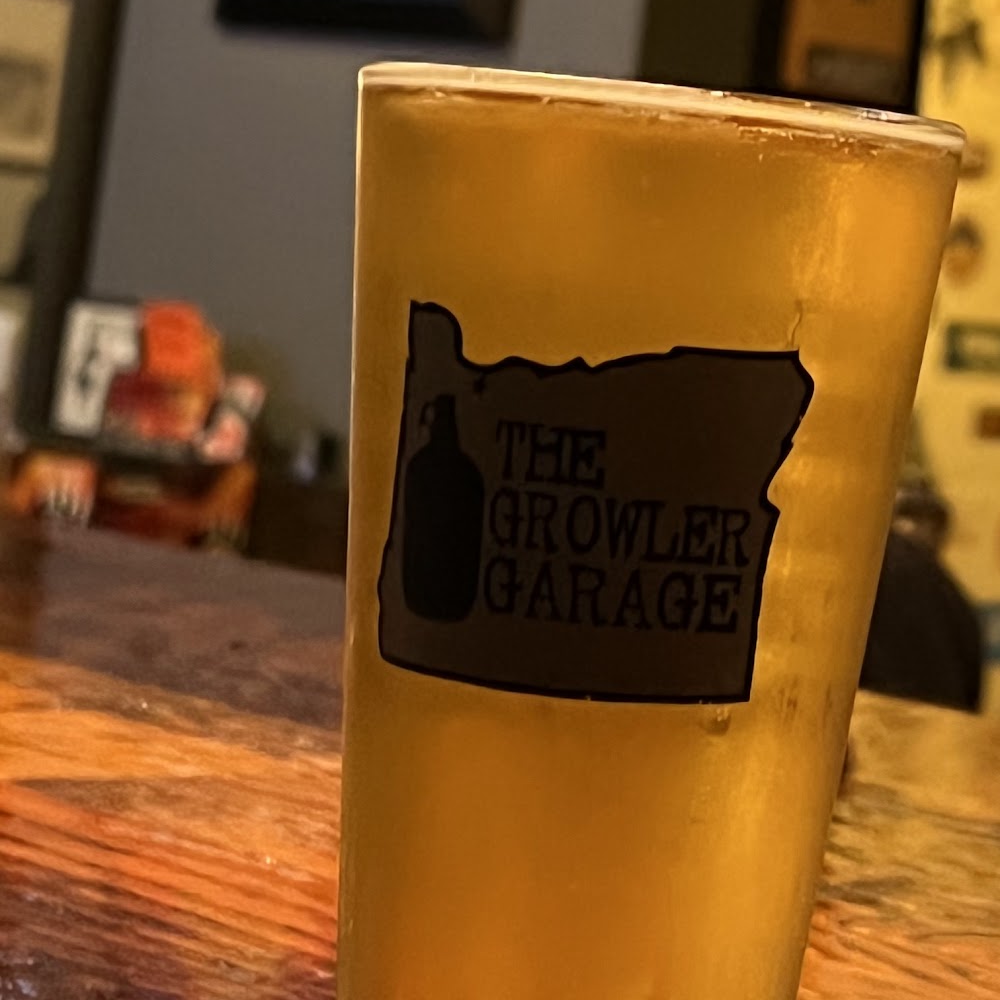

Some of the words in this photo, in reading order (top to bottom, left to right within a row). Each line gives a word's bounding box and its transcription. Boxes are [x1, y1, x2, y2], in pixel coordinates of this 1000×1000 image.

[497, 421, 607, 488] THE
[489, 488, 752, 567] GROWLER
[484, 557, 742, 633] GARAGE
